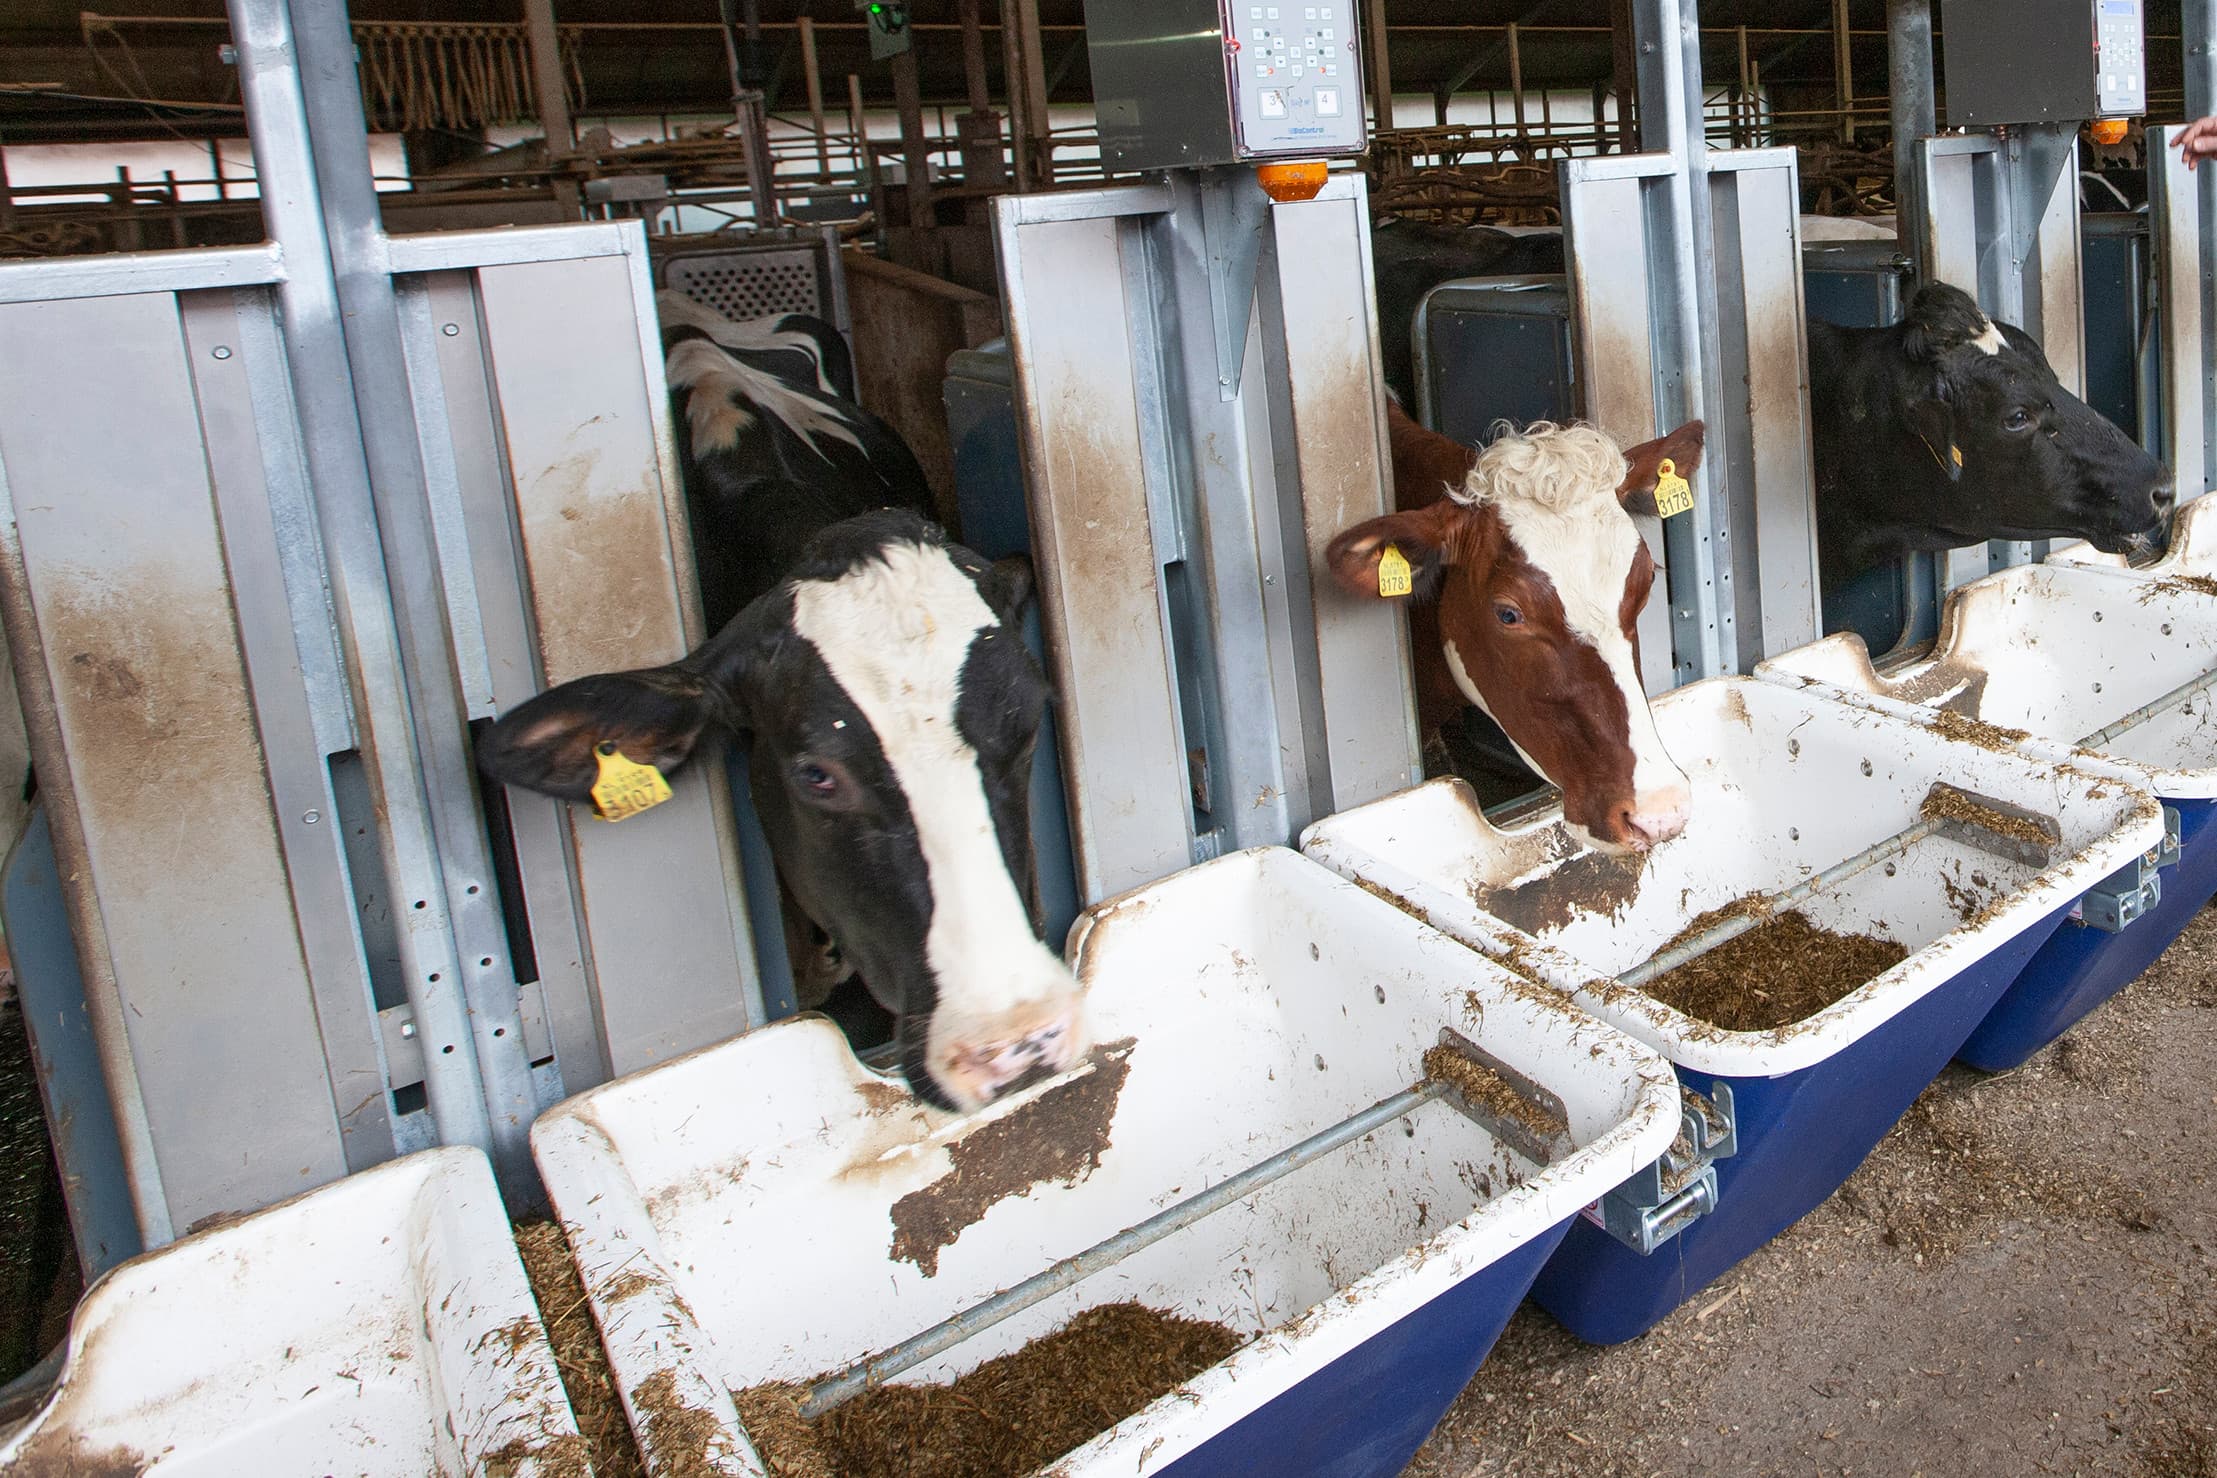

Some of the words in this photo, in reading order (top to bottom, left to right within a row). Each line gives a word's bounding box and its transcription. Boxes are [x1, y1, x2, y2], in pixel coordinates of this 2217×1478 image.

[1269, 95, 1277, 106] 3
[1321, 93, 1328, 104] 4
[1659, 491, 1690, 516] 3178
[1381, 576, 1405, 592] 3178
